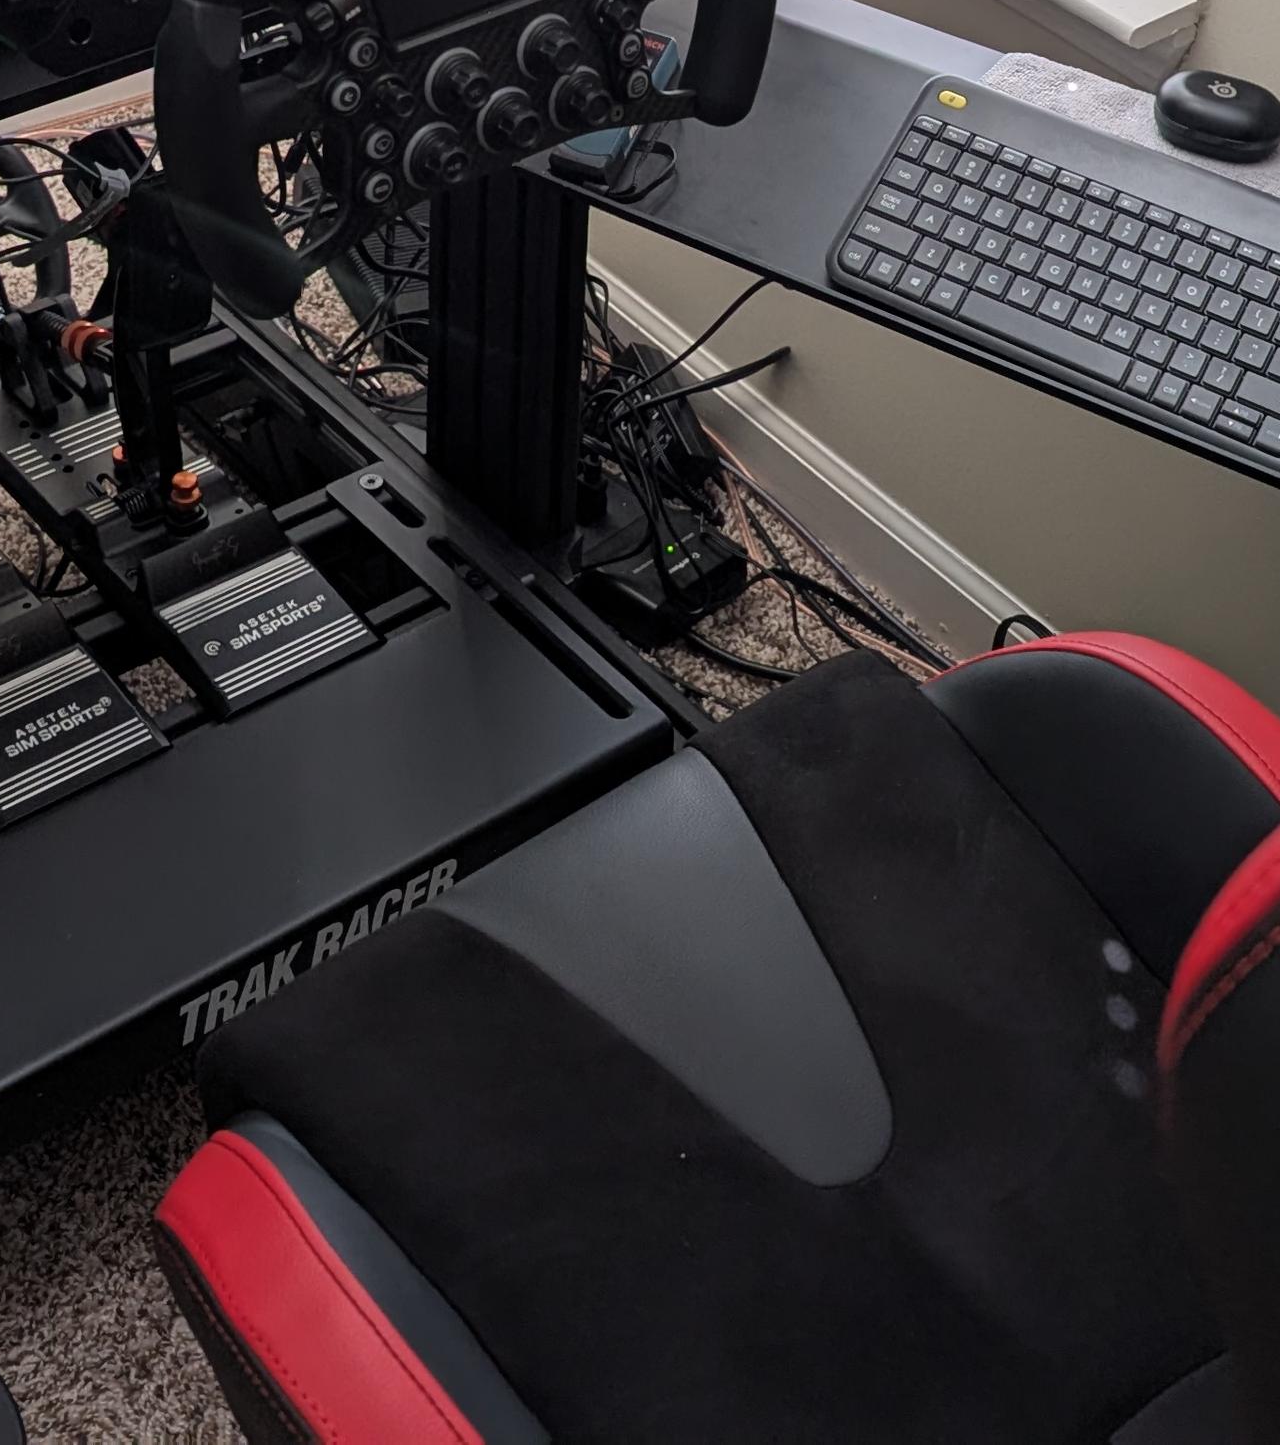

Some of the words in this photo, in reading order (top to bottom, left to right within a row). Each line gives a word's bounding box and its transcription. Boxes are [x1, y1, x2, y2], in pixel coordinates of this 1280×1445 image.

[932, 183, 944, 194] Q
[963, 195, 975, 206] W
[994, 208, 1004, 218] E
[1025, 220, 1035, 231] R
[1058, 233, 1066, 243] T
[1090, 246, 1099, 256] Y
[1121, 259, 1132, 270] U
[924, 215, 934, 224] A
[957, 226, 965, 236] S
[986, 239, 997, 249] D
[1018, 252, 1028, 261] F
[1049, 265, 1061, 275] G
[1081, 278, 1092, 289] H
[1114, 292, 1124, 302] J
[1147, 304, 1157, 315] K
[1180, 318, 1188, 329] L
[926, 248, 936, 259] Z
[956, 261, 967, 272] X
[988, 274, 999, 285] C
[1021, 287, 1030, 297] V
[1052, 300, 1061, 311] B
[1083, 314, 1095, 325] N
[1114, 327, 1128, 339] M
[229, 624, 261, 650] SIM
[238, 599, 299, 634] ASETEK
[4, 732, 38, 758] SIM
[14, 701, 81, 739] ASETEK
[179, 941, 303, 1047] TRAK
[311, 858, 458, 970] RACER
